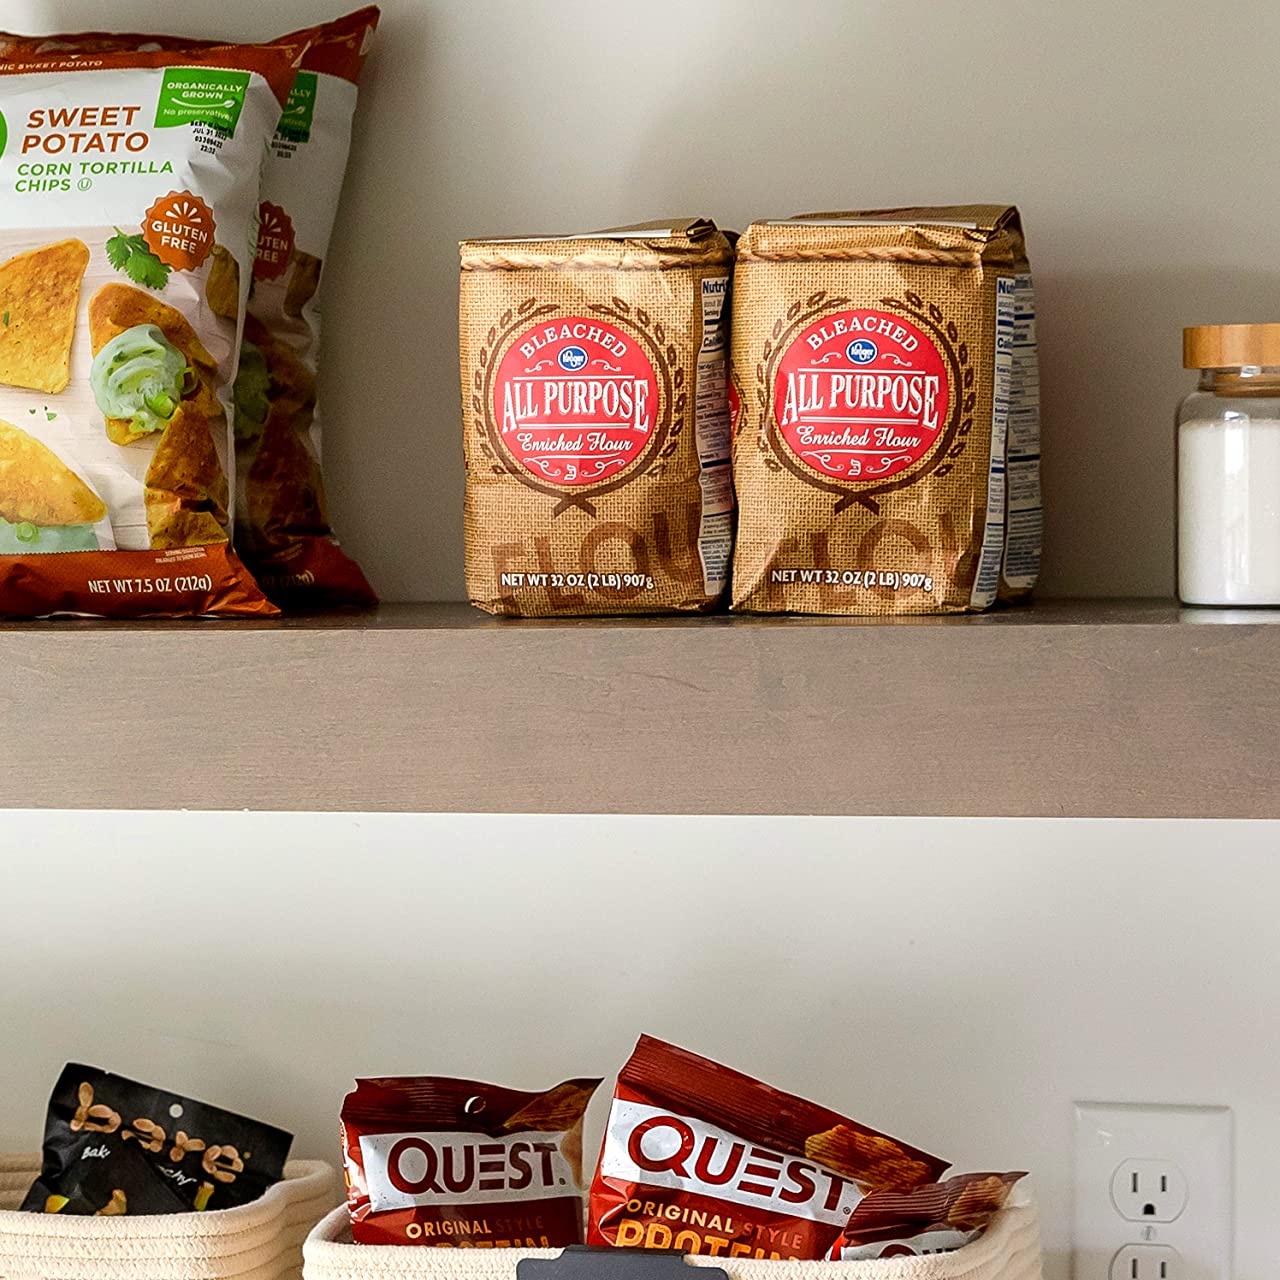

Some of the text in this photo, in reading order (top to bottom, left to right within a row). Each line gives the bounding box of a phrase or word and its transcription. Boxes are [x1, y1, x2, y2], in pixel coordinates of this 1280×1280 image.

[18, 61, 57, 70] SWEET
[59, 60, 103, 68] POTATO
[167, 82, 243, 93] ORGANICALLY
[182, 91, 223, 99] GROWN
[26, 106, 141, 128] SWEET
[163, 108, 174, 116] No
[21, 132, 149, 154] POTATO
[17, 161, 174, 176] CORN TORTILLA
[15, 178, 71, 193] CHIPS
[151, 220, 208, 243] GLUTEN
[161, 235, 197, 255] FREE
[520, 323, 627, 359] BLEACHED
[806, 316, 919, 353] BLEACHED
[562, 350, 585, 367] Kroger
[851, 343, 874, 361] Kroger
[502, 379, 649, 434] ALL PURPOSE
[781, 372, 939, 431] ALL PURPOSE
[517, 432, 634, 451] Enriched Flour
[796, 426, 922, 448] Enriched Flour
[88, 580, 112, 593] NET
[113, 579, 133, 593] WT
[135, 578, 153, 593] 7.5
[155, 577, 172, 592] OZ
[501, 573, 654, 590] NET WT 32 OZ (2 LB) 907g
[772, 570, 933, 592] NET WT 32 OZ (2 LB) 907g
[388, 1137, 558, 1194] QUEST
[628, 1115, 854, 1211] QUEST
[405, 1215, 544, 1239] ORIGINAL STYLE
[627, 1198, 804, 1250] ORIGINAL STYLE
